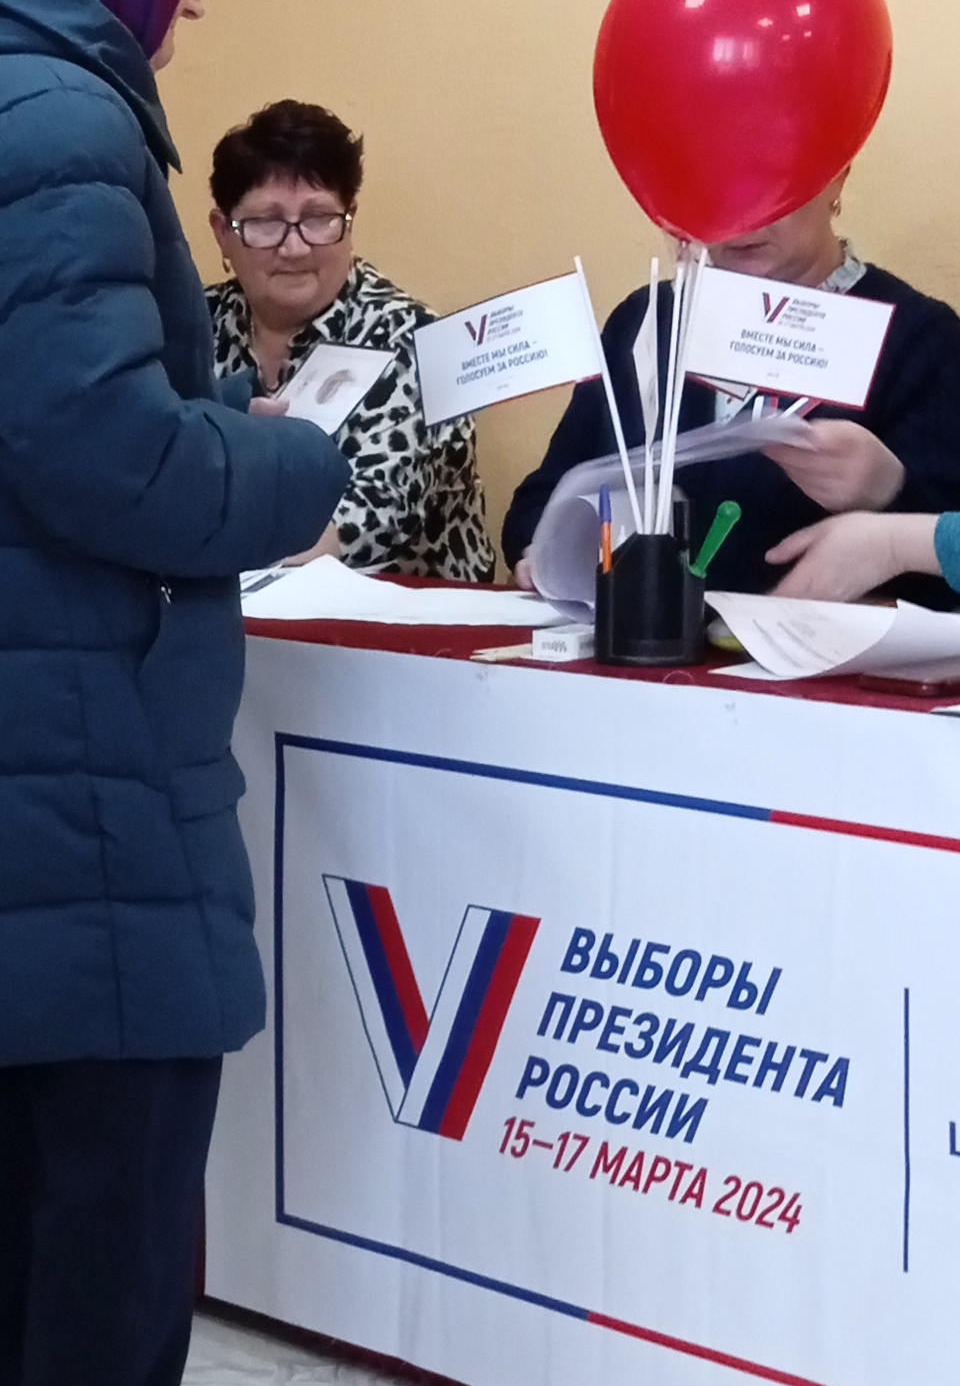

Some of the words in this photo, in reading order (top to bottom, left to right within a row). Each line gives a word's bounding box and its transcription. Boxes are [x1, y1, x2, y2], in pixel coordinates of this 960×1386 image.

[456, 364, 496, 386] ГОЛОСУЕМ
[497, 361, 508, 373] ЗА
[508, 348, 549, 367] РОССИЮ!
[461, 352, 490, 371] ВМЕСТЕ
[492, 348, 506, 360] МЫ
[507, 340, 531, 354] СИЛА
[729, 340, 775, 359] ГОЛОСУЕМ
[775, 350, 786, 361] ЗА
[787, 352, 830, 370] РОССИЮ!
[740, 328, 775, 345] ВМЕСТЕ
[775, 336, 792, 348] МЫ
[793, 339, 817, 353] СИЛА
[560, 926, 783, 1016] ВЫБОРЫ
[536, 991, 851, 1109] ПРЕЗИДЕНТА
[515, 1055, 709, 1144] РОССИИ
[589, 1140, 708, 1209] МАРТА
[712, 1174, 803, 1234] 2024
